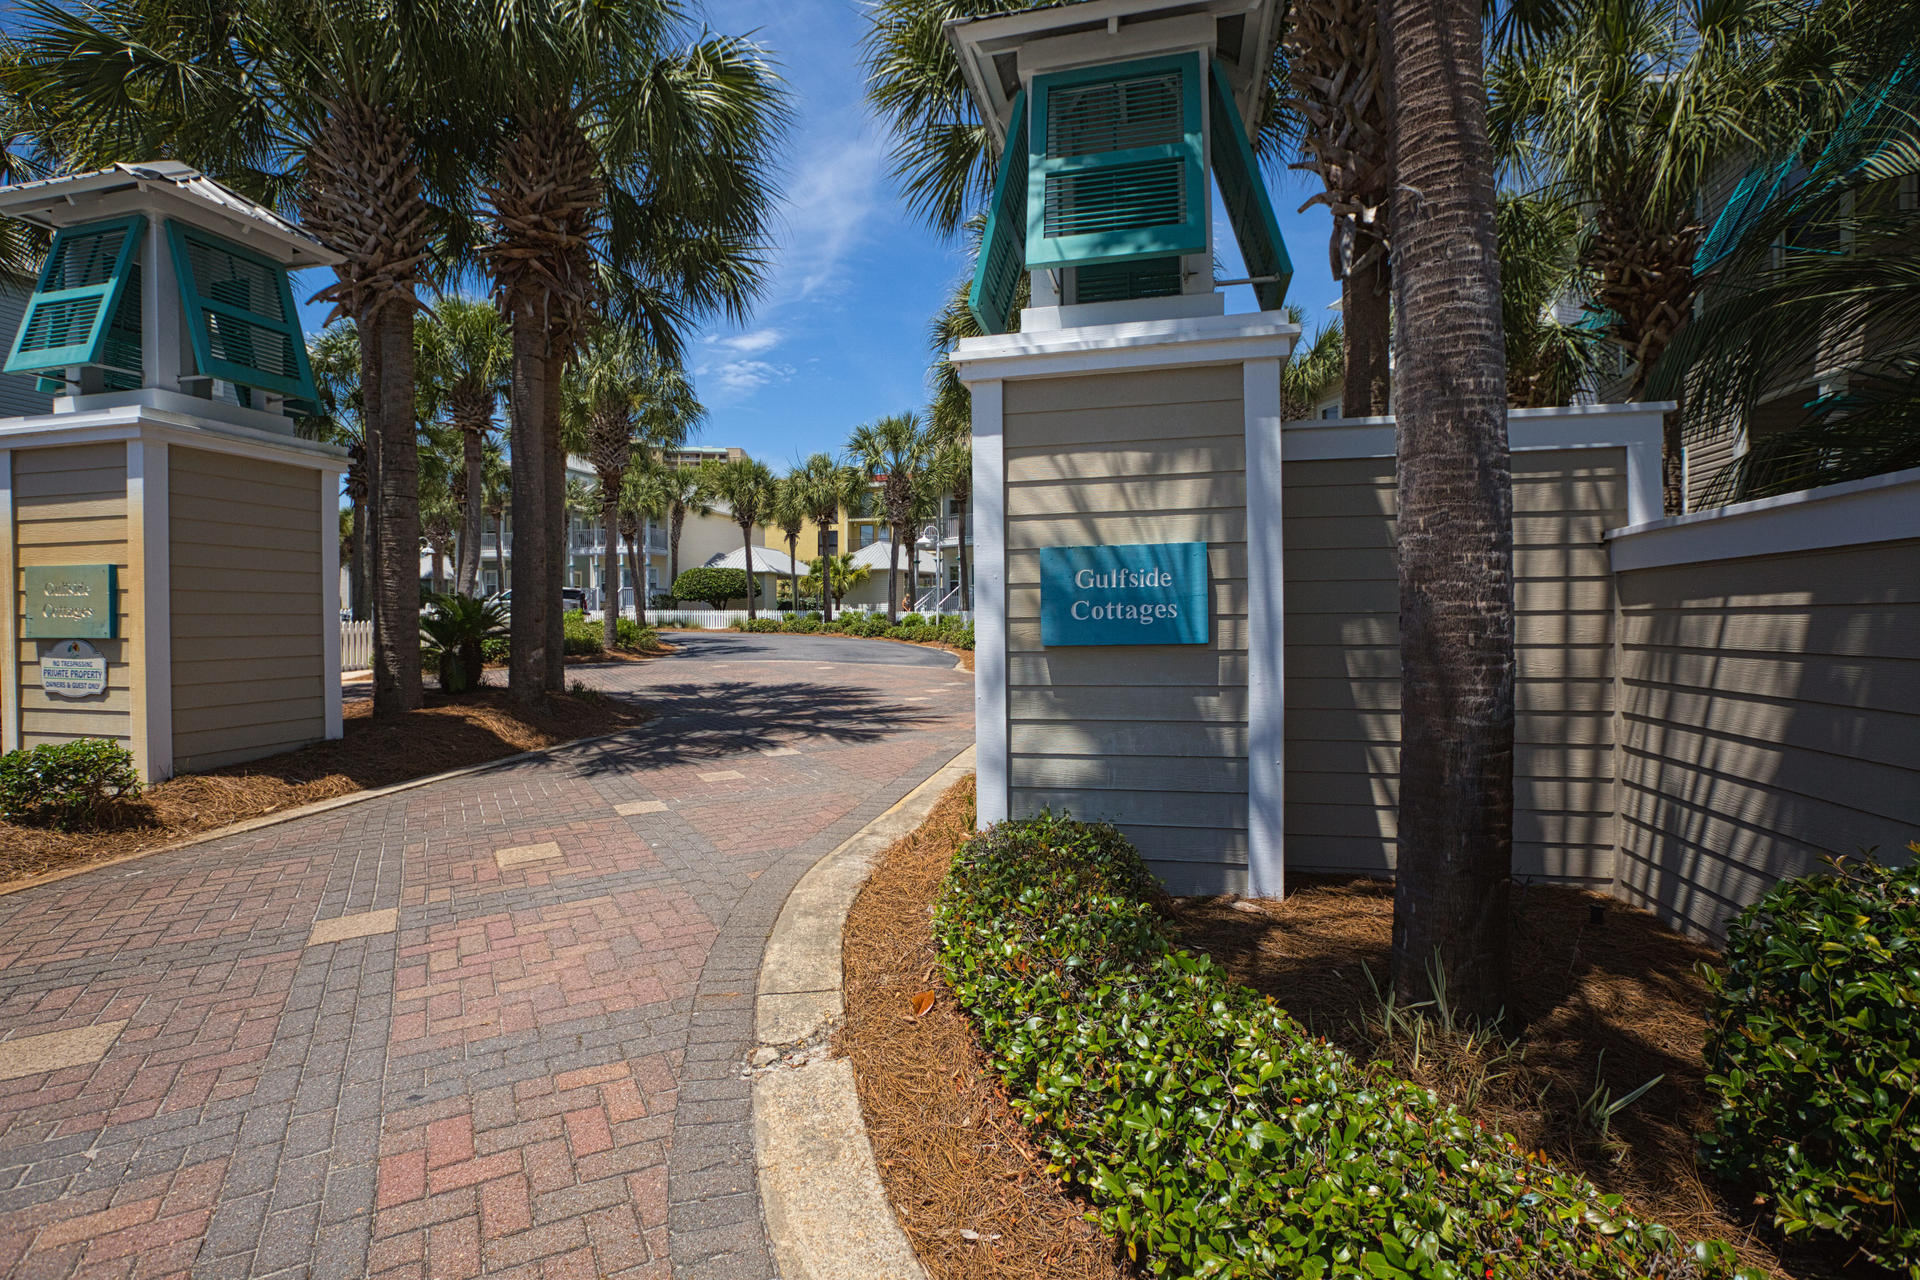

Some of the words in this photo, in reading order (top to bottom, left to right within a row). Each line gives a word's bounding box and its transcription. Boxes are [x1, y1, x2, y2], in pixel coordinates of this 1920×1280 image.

[1075, 567, 1172, 589] Gulfside
[43, 582, 91, 597] Gulfside
[1071, 600, 1178, 625] Cottages
[61, 660, 93, 668] TRESPASSING
[43, 669, 69, 678] PRIVATE
[70, 669, 102, 679] PROPERTY
[88, 682, 100, 690] ONLY
